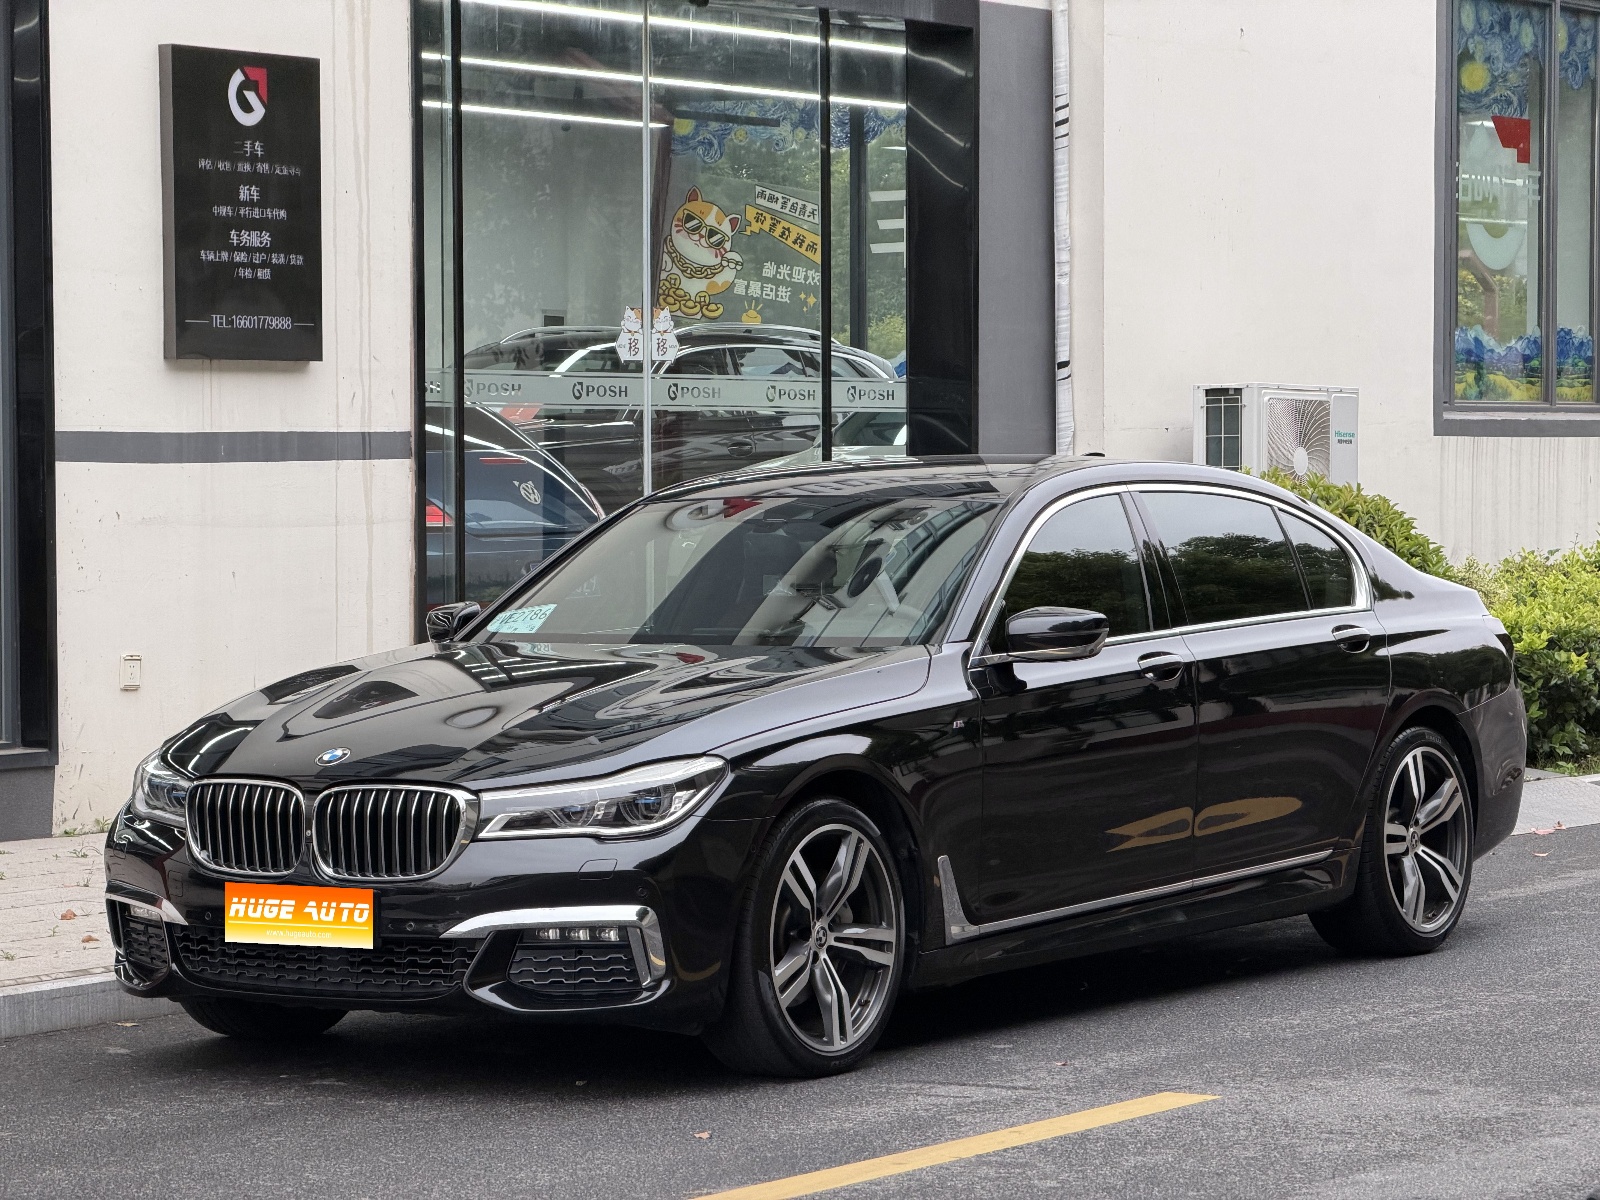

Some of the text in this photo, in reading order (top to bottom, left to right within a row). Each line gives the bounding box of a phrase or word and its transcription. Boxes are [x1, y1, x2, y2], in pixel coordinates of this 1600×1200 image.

[233, 140, 265, 157] 二手车
[238, 184, 261, 202] 新车
[228, 229, 272, 247] 车务服务
[210, 314, 292, 330] TEL:16601779888
[628, 337, 640, 357] 移
[656, 337, 668, 357] 移
[585, 384, 628, 398] POSH
[681, 386, 721, 399] POSH
[778, 388, 816, 401] POSH
[858, 389, 895, 401] POSH
